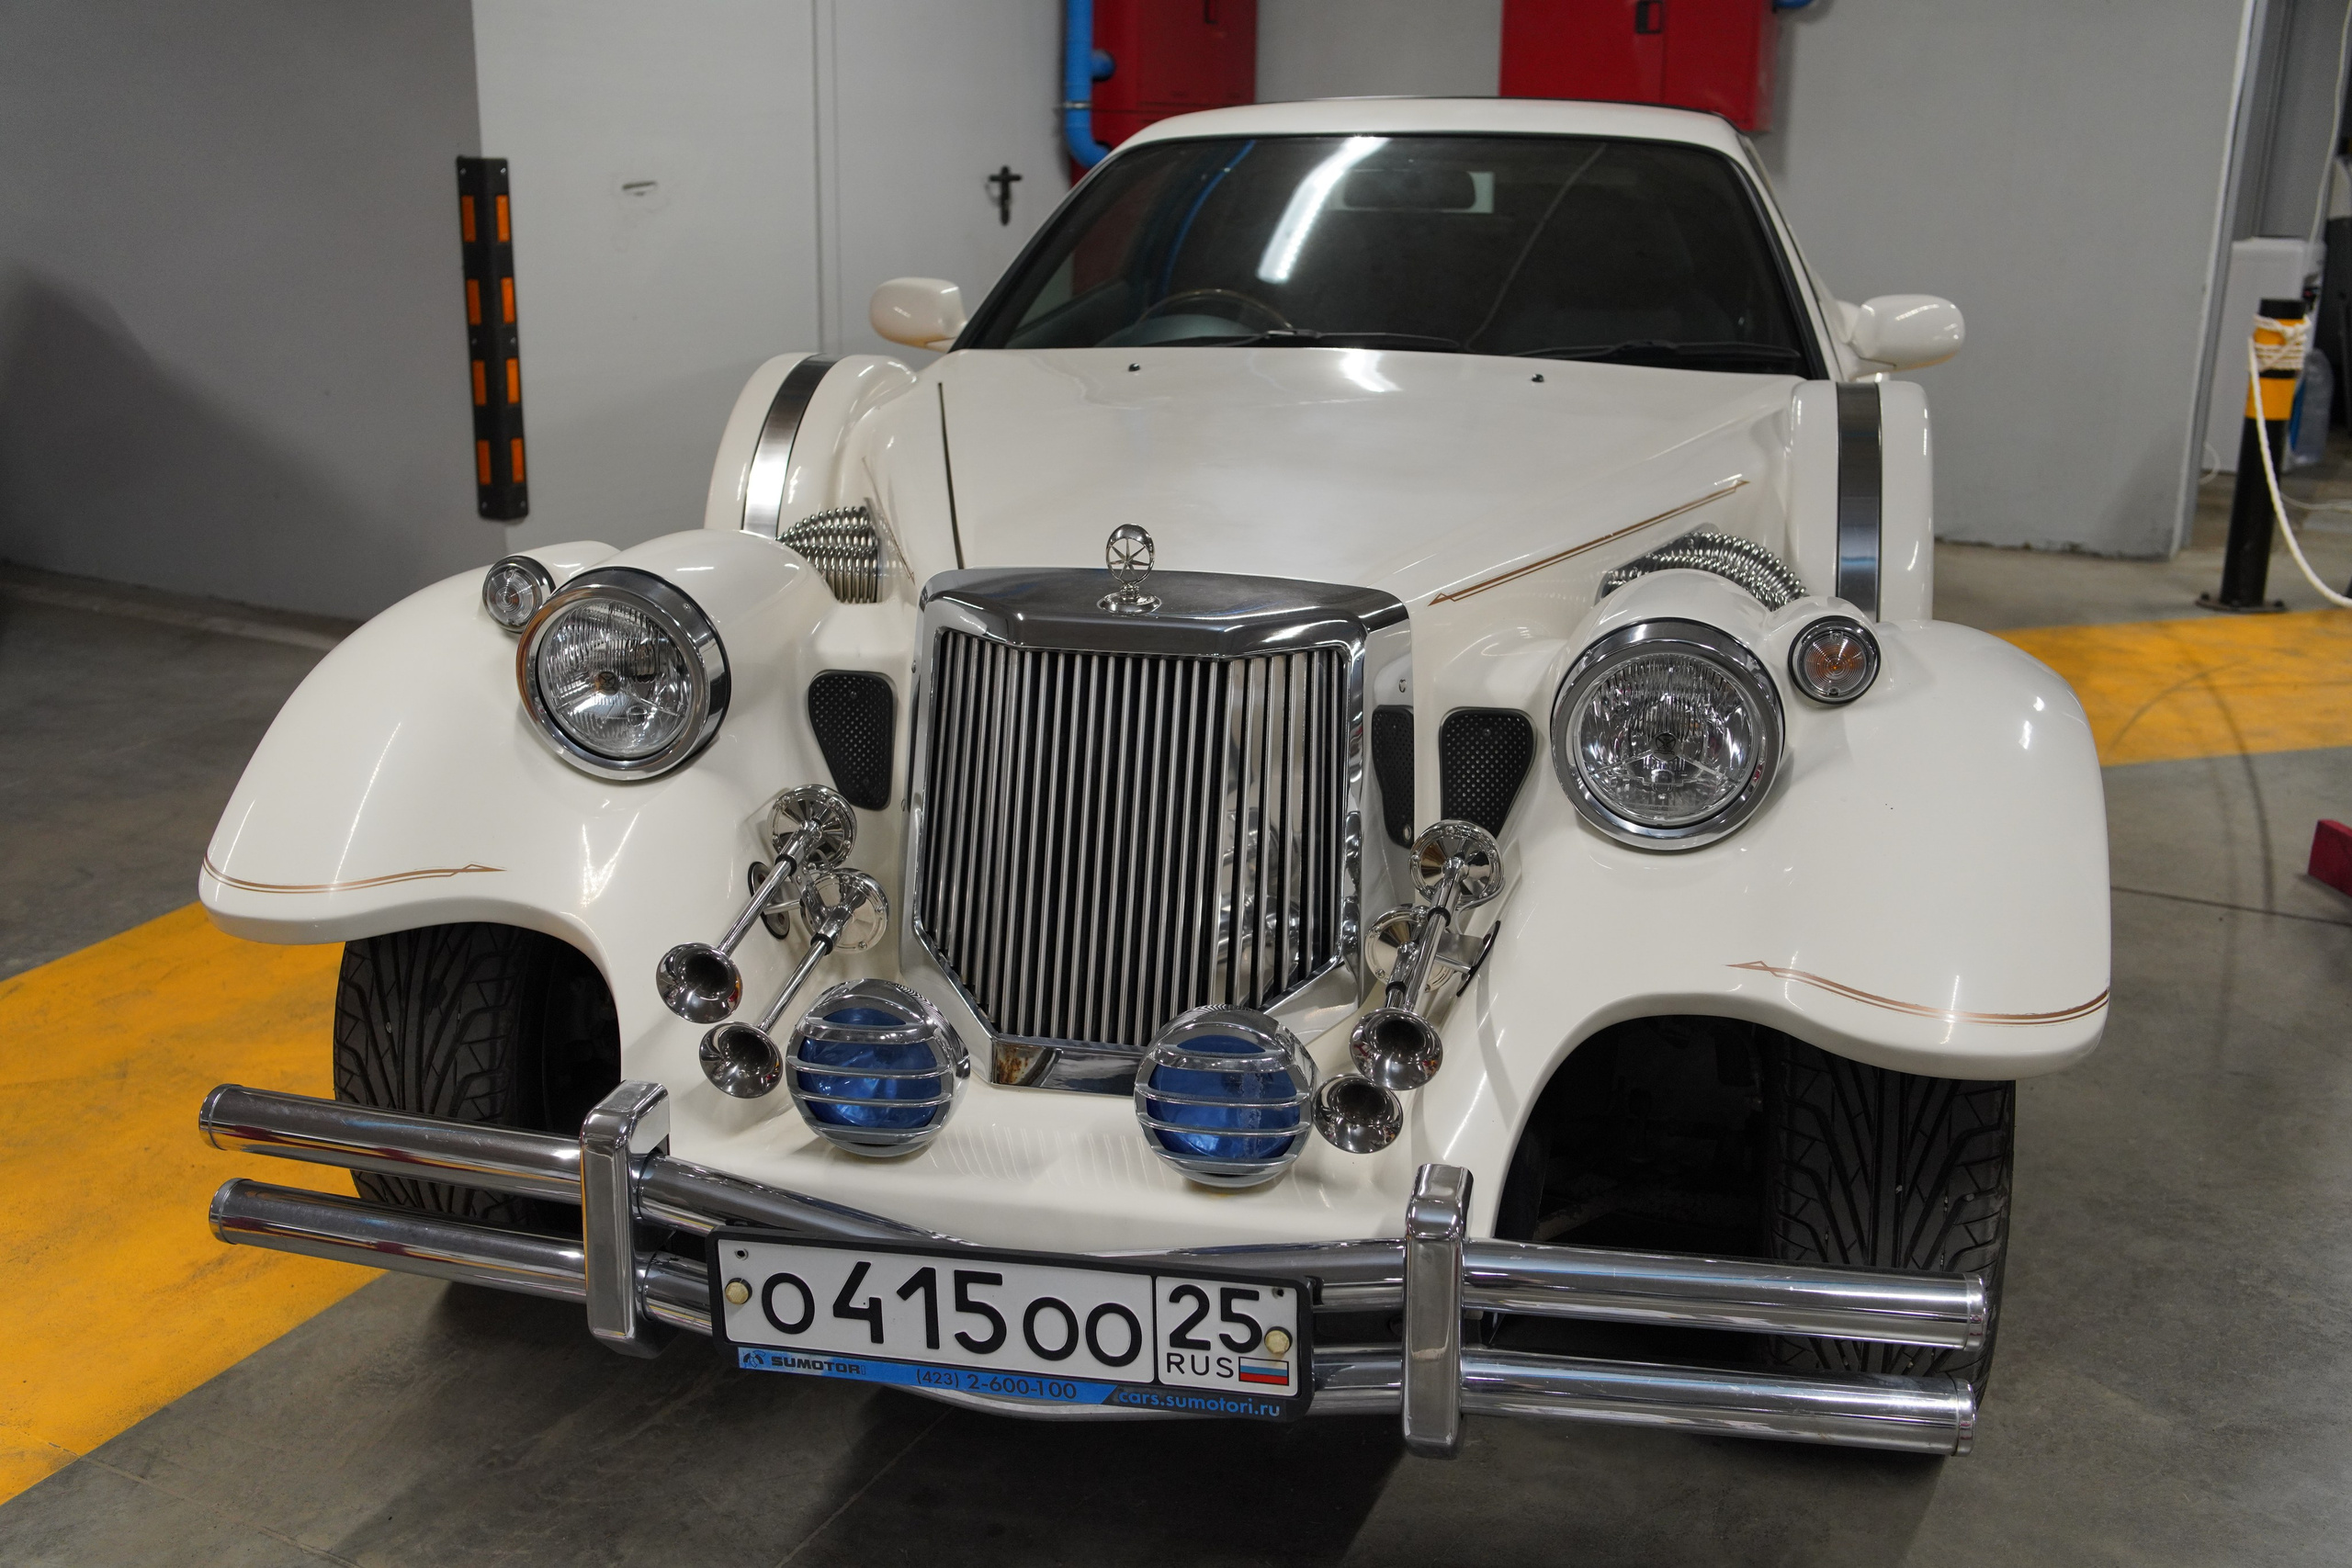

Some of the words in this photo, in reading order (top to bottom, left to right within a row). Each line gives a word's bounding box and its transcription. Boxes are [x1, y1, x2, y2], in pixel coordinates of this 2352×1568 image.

[1169, 1283, 1263, 1354] 25
[1166, 1352, 1234, 1379] RUS
[916, 1368, 959, 1389] (423)
[966, 1373, 1077, 1400] 2-600-100
[1117, 1390, 1281, 1417] cars.sumotori.ru
